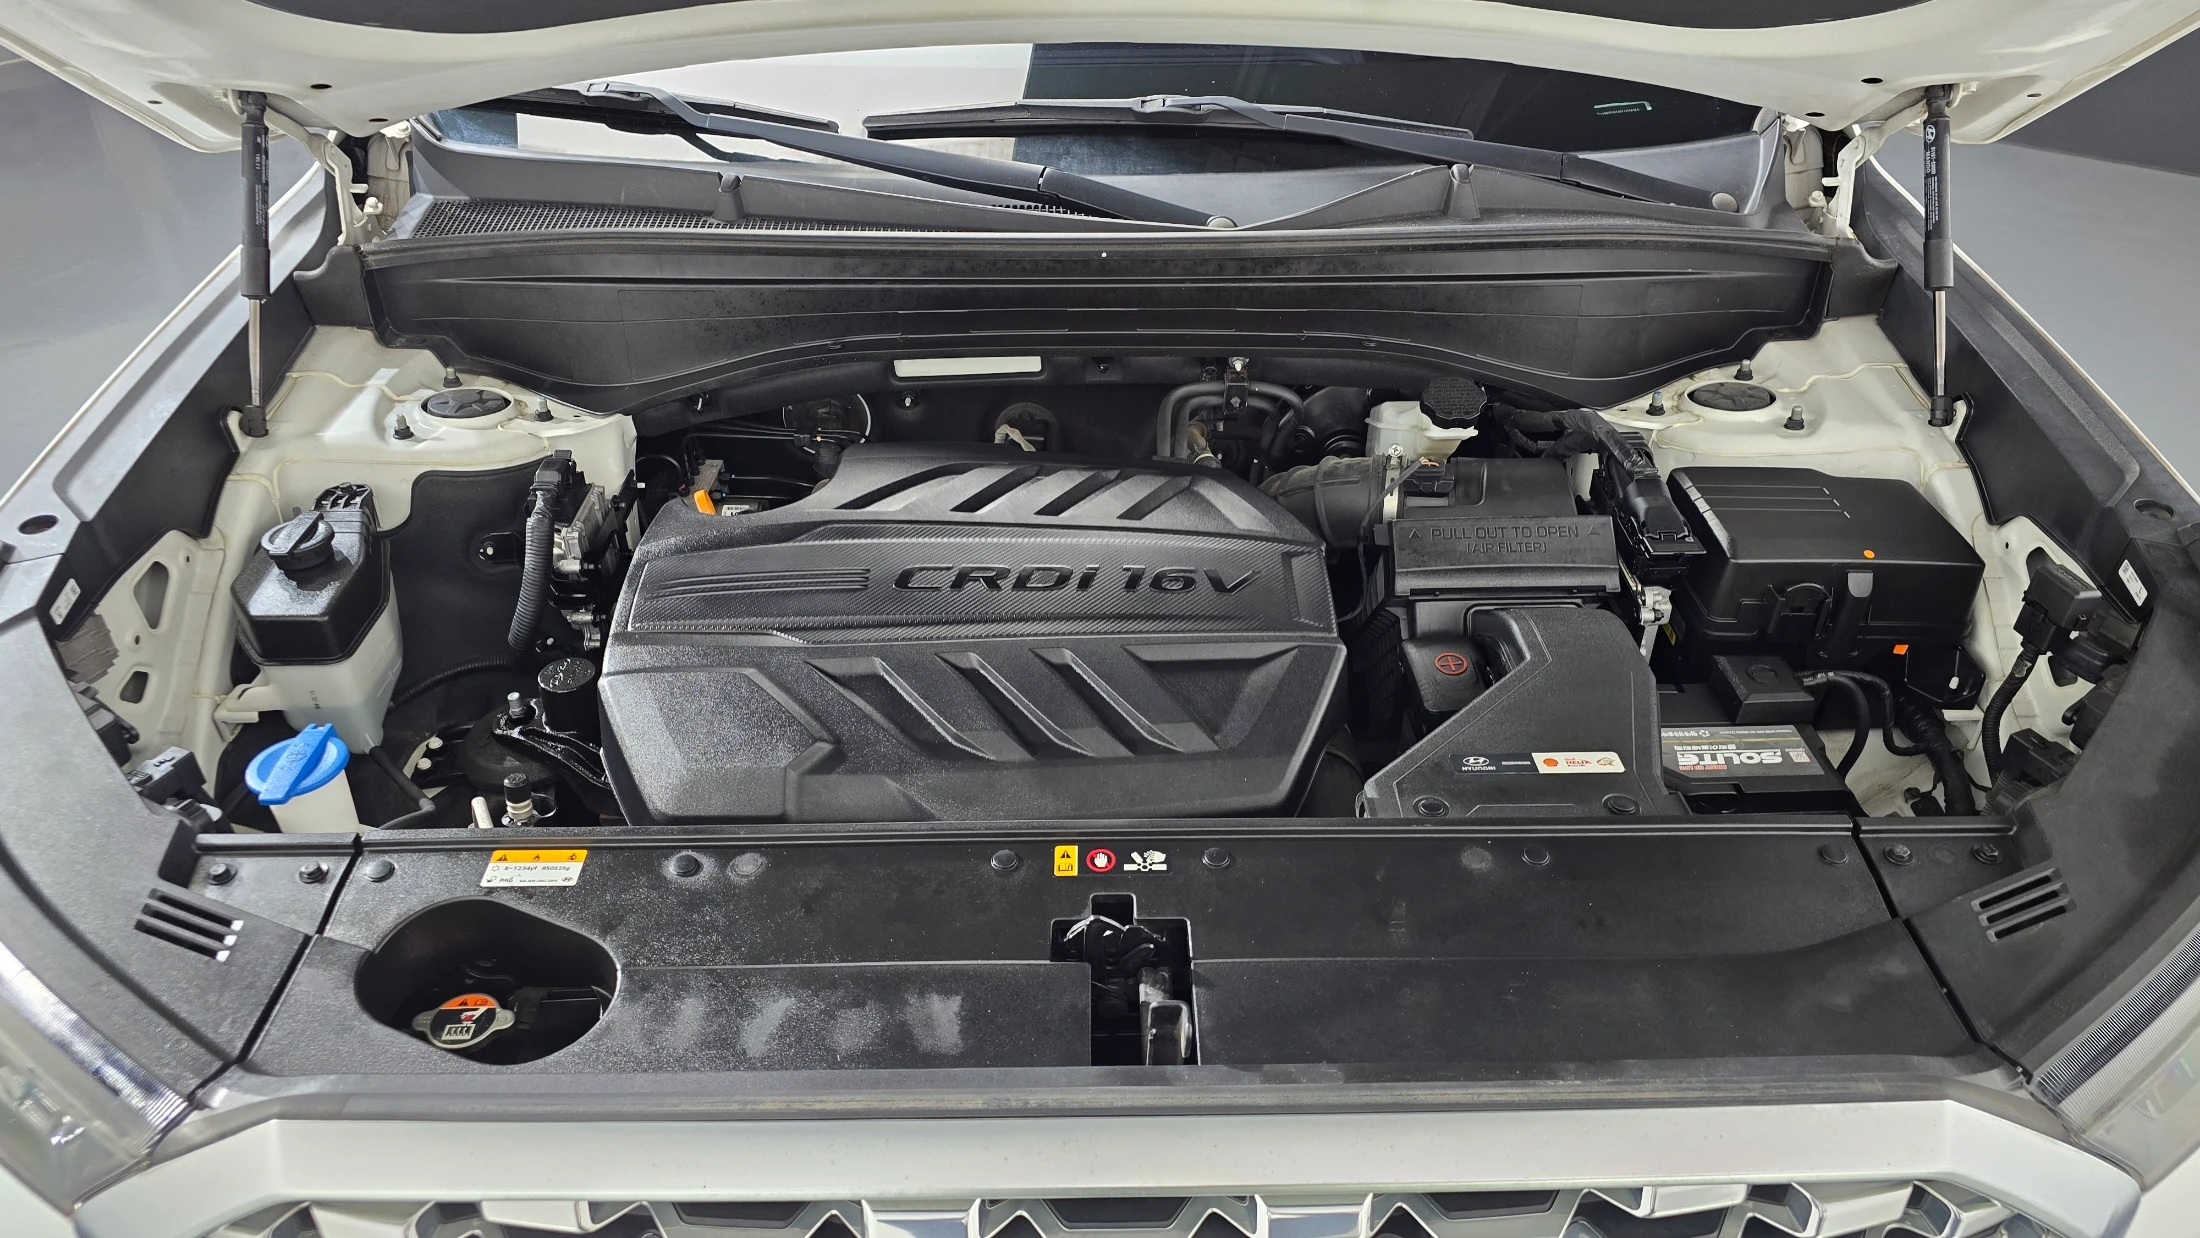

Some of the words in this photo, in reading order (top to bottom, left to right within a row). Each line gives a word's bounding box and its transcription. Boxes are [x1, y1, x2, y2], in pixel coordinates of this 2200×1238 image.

[1430, 527, 1471, 541] PULL
[1474, 526, 1507, 540] OUT
[1510, 525, 1533, 539] TO
[1536, 524, 1579, 538] OPEN
[893, 564, 1101, 593] CRDi
[1121, 564, 1263, 596] 16V
[1676, 749, 1783, 766] SOLITE
